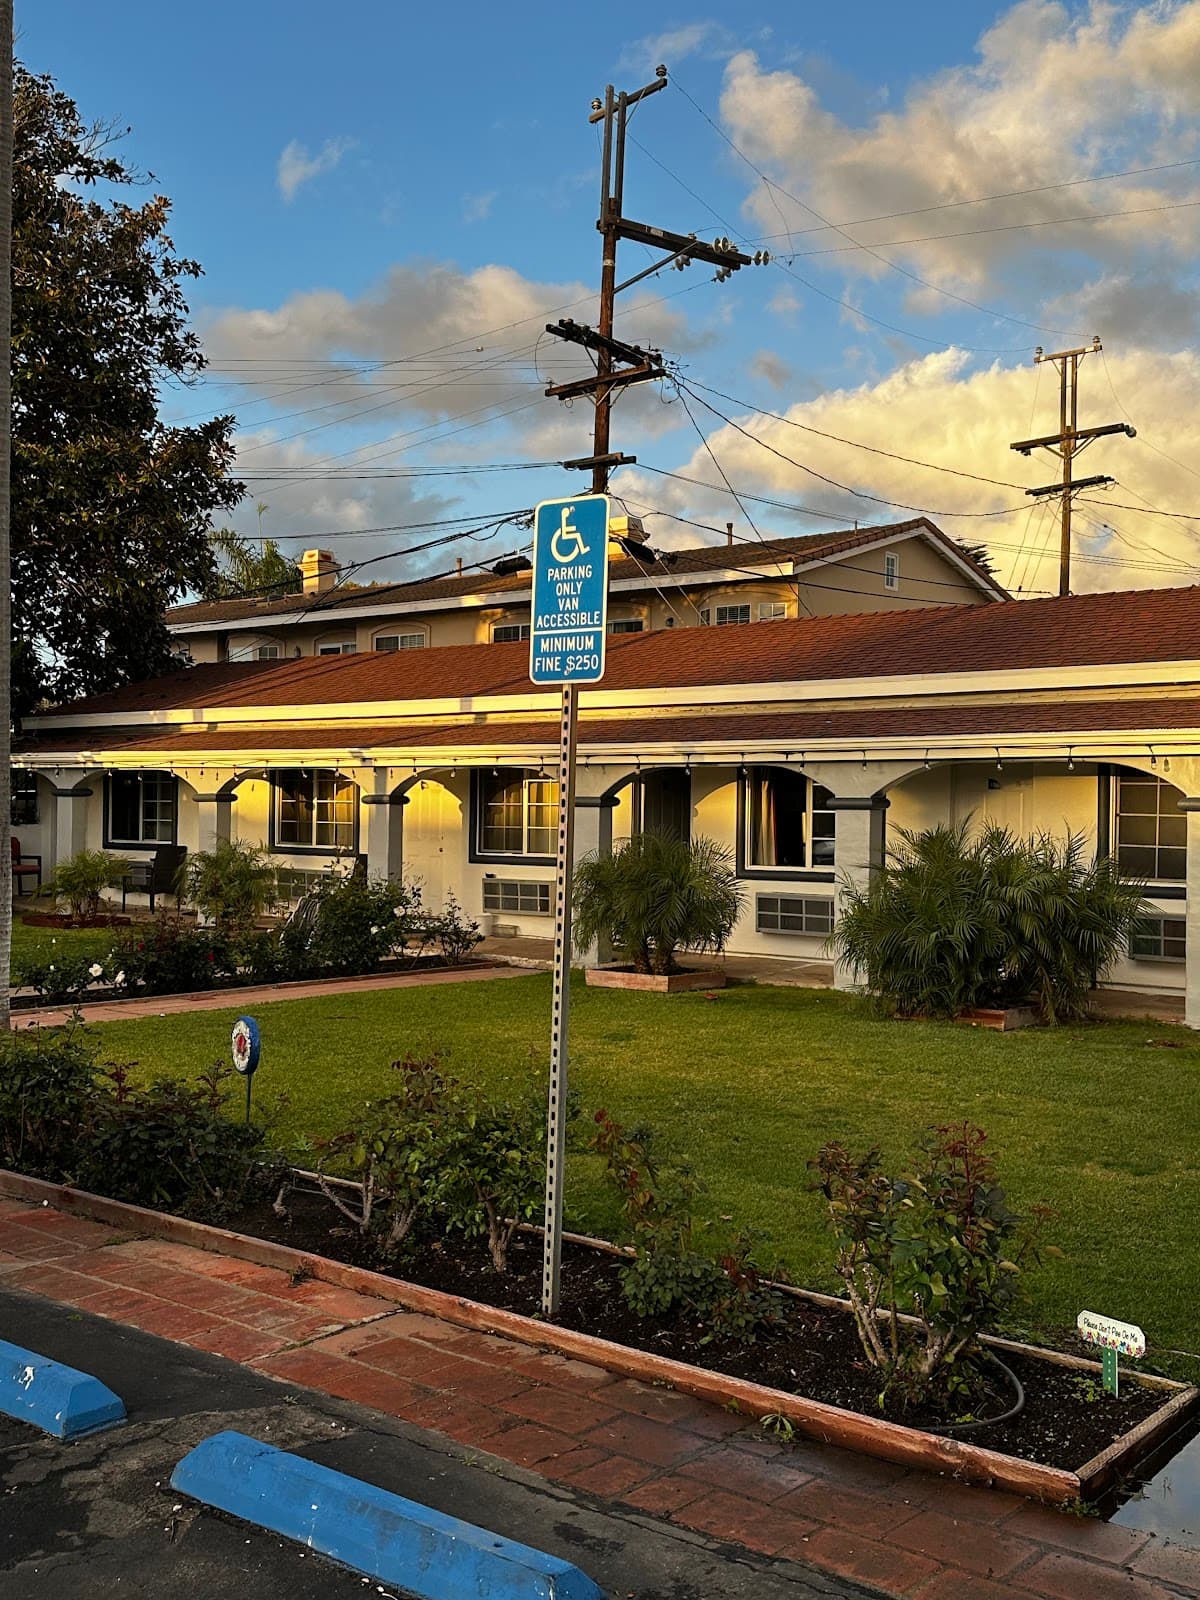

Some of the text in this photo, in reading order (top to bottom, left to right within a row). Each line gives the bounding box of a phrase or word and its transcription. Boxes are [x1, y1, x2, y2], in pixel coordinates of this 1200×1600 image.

[547, 565, 592, 581] PARKING
[556, 581, 583, 596] ONLY
[558, 597, 579, 611] VAN
[536, 611, 600, 628] ACCESSIBLE
[540, 635, 594, 653] MINIMUM
[535, 655, 599, 673] FINE $250
